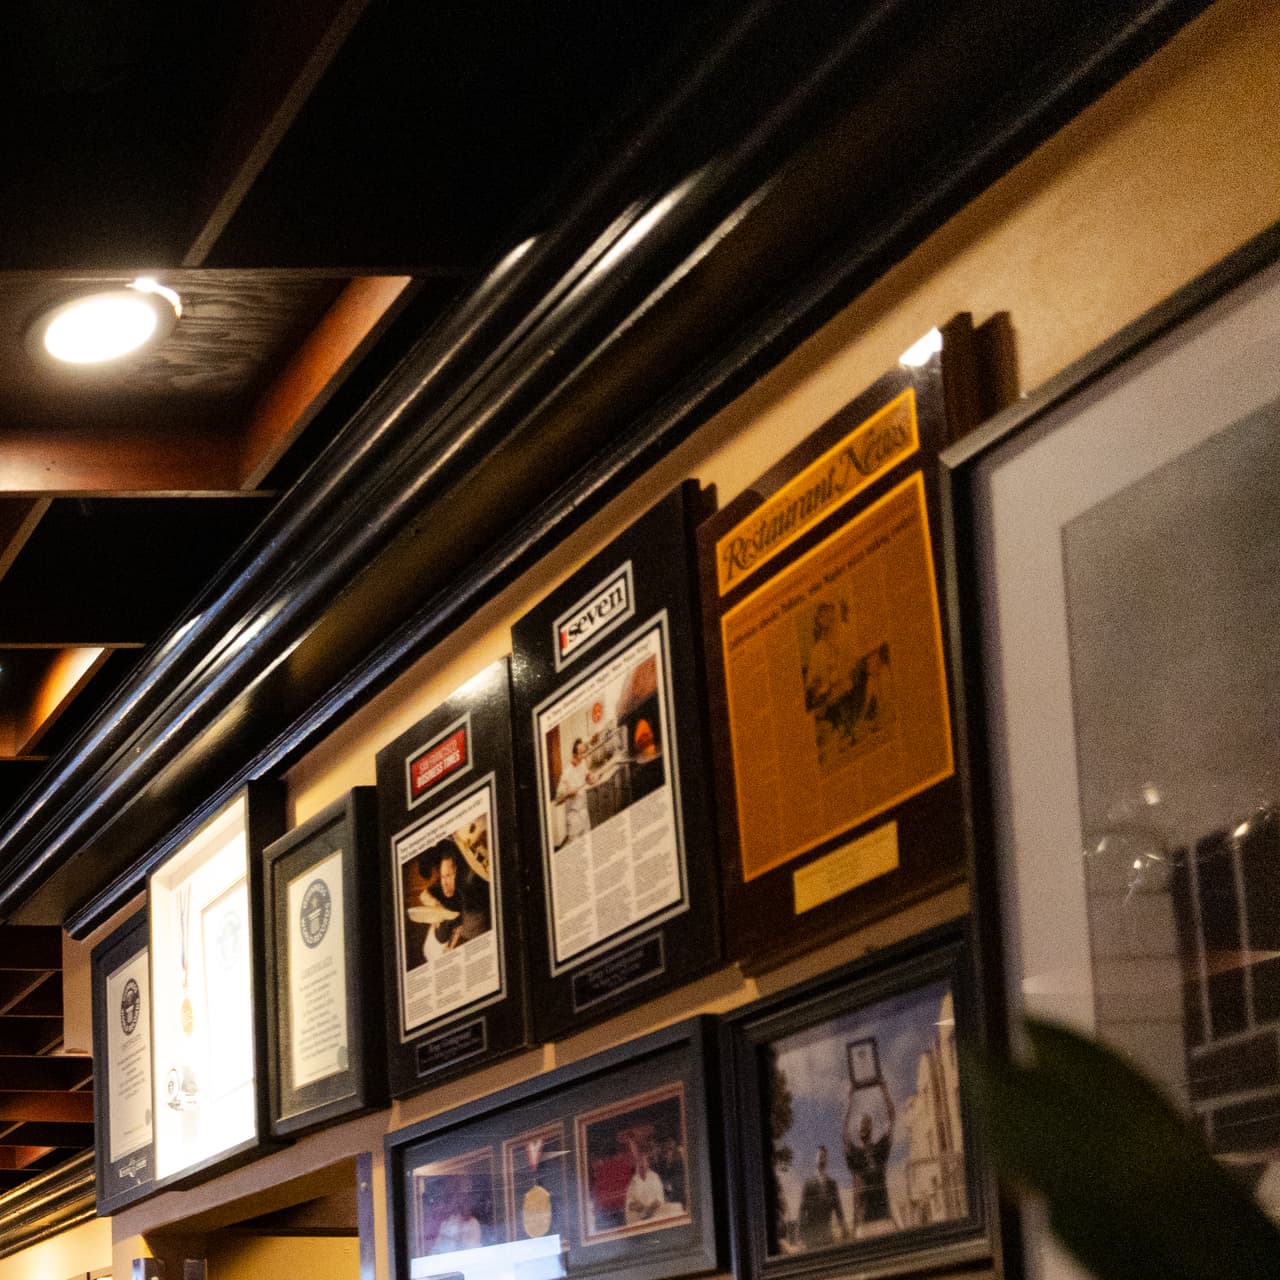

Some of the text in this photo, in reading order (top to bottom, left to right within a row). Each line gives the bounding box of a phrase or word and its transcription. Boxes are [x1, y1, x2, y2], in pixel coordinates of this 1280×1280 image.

[724, 466, 834, 582] Restaurant
[837, 423, 907, 489] News
[568, 586, 624, 643] seven
